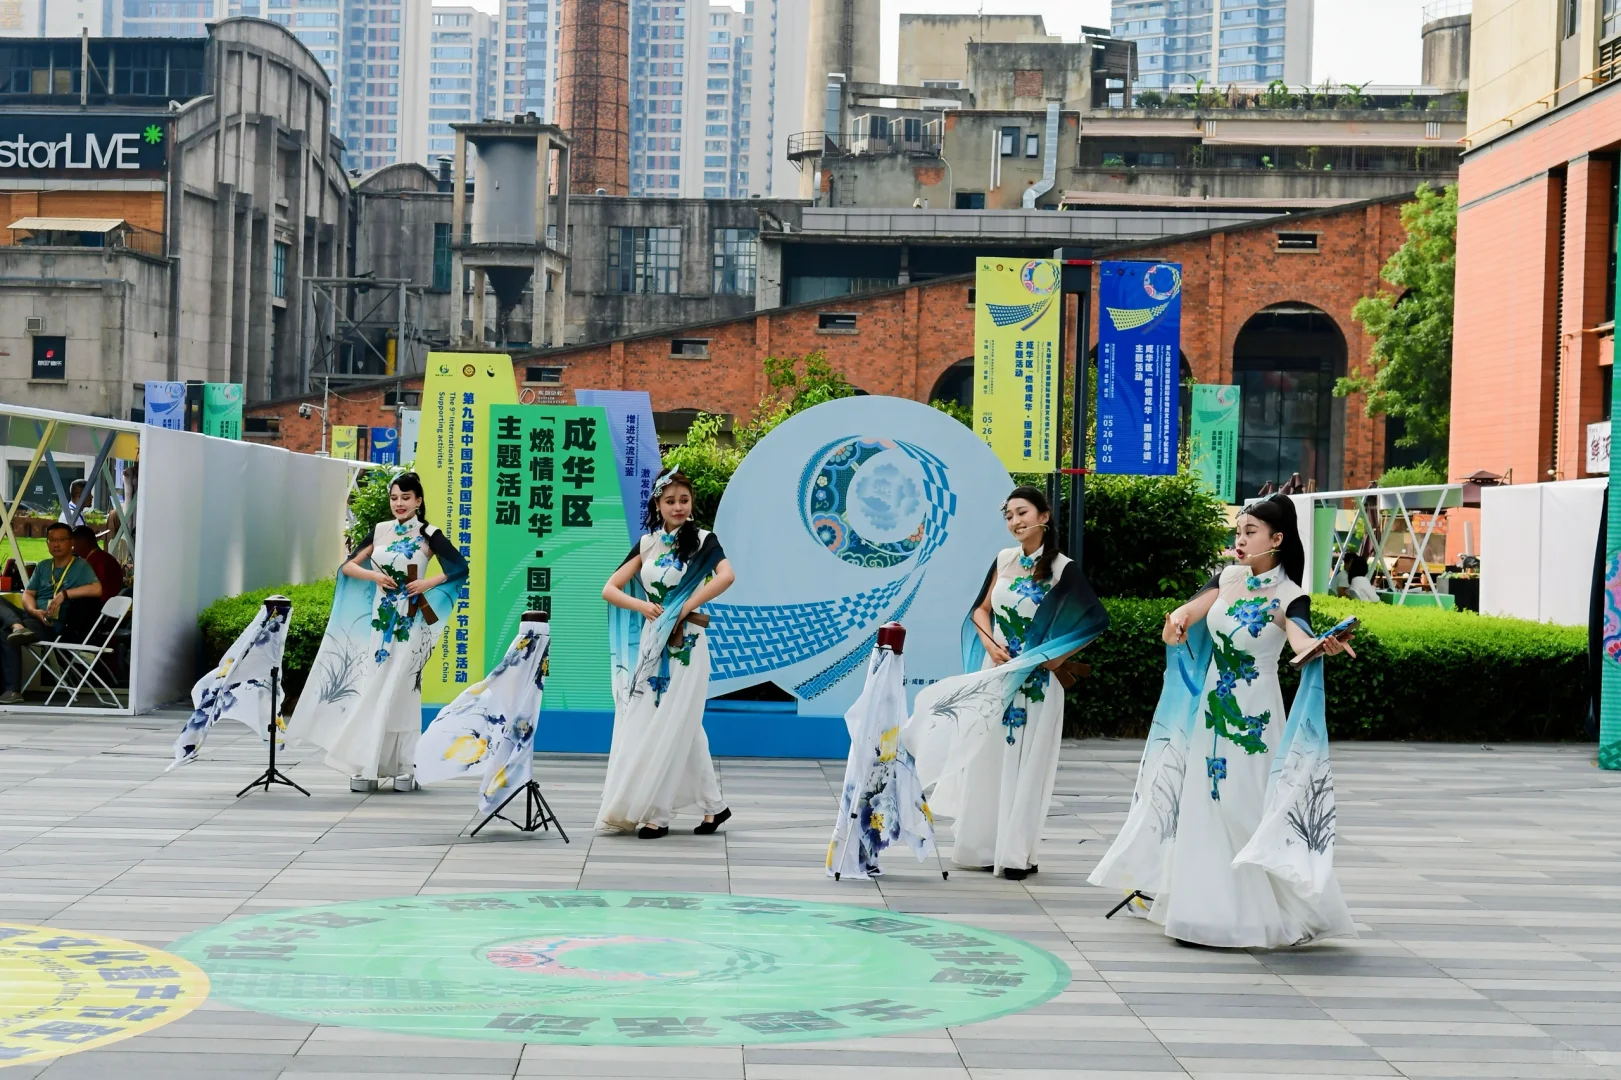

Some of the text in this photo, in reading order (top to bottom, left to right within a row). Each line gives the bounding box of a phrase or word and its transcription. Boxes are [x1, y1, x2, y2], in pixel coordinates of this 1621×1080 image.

[1014, 340, 1024, 378] 主题活动
[1134, 343, 1144, 381] 主题活动
[437, 391, 446, 469] Supporting activities
[447, 416, 456, 465] International
[625, 414, 636, 477] 增进交流互鉴
[495, 415, 522, 527] 主题活动
[562, 417, 597, 528] 成华区
[447, 496, 454, 504] of
